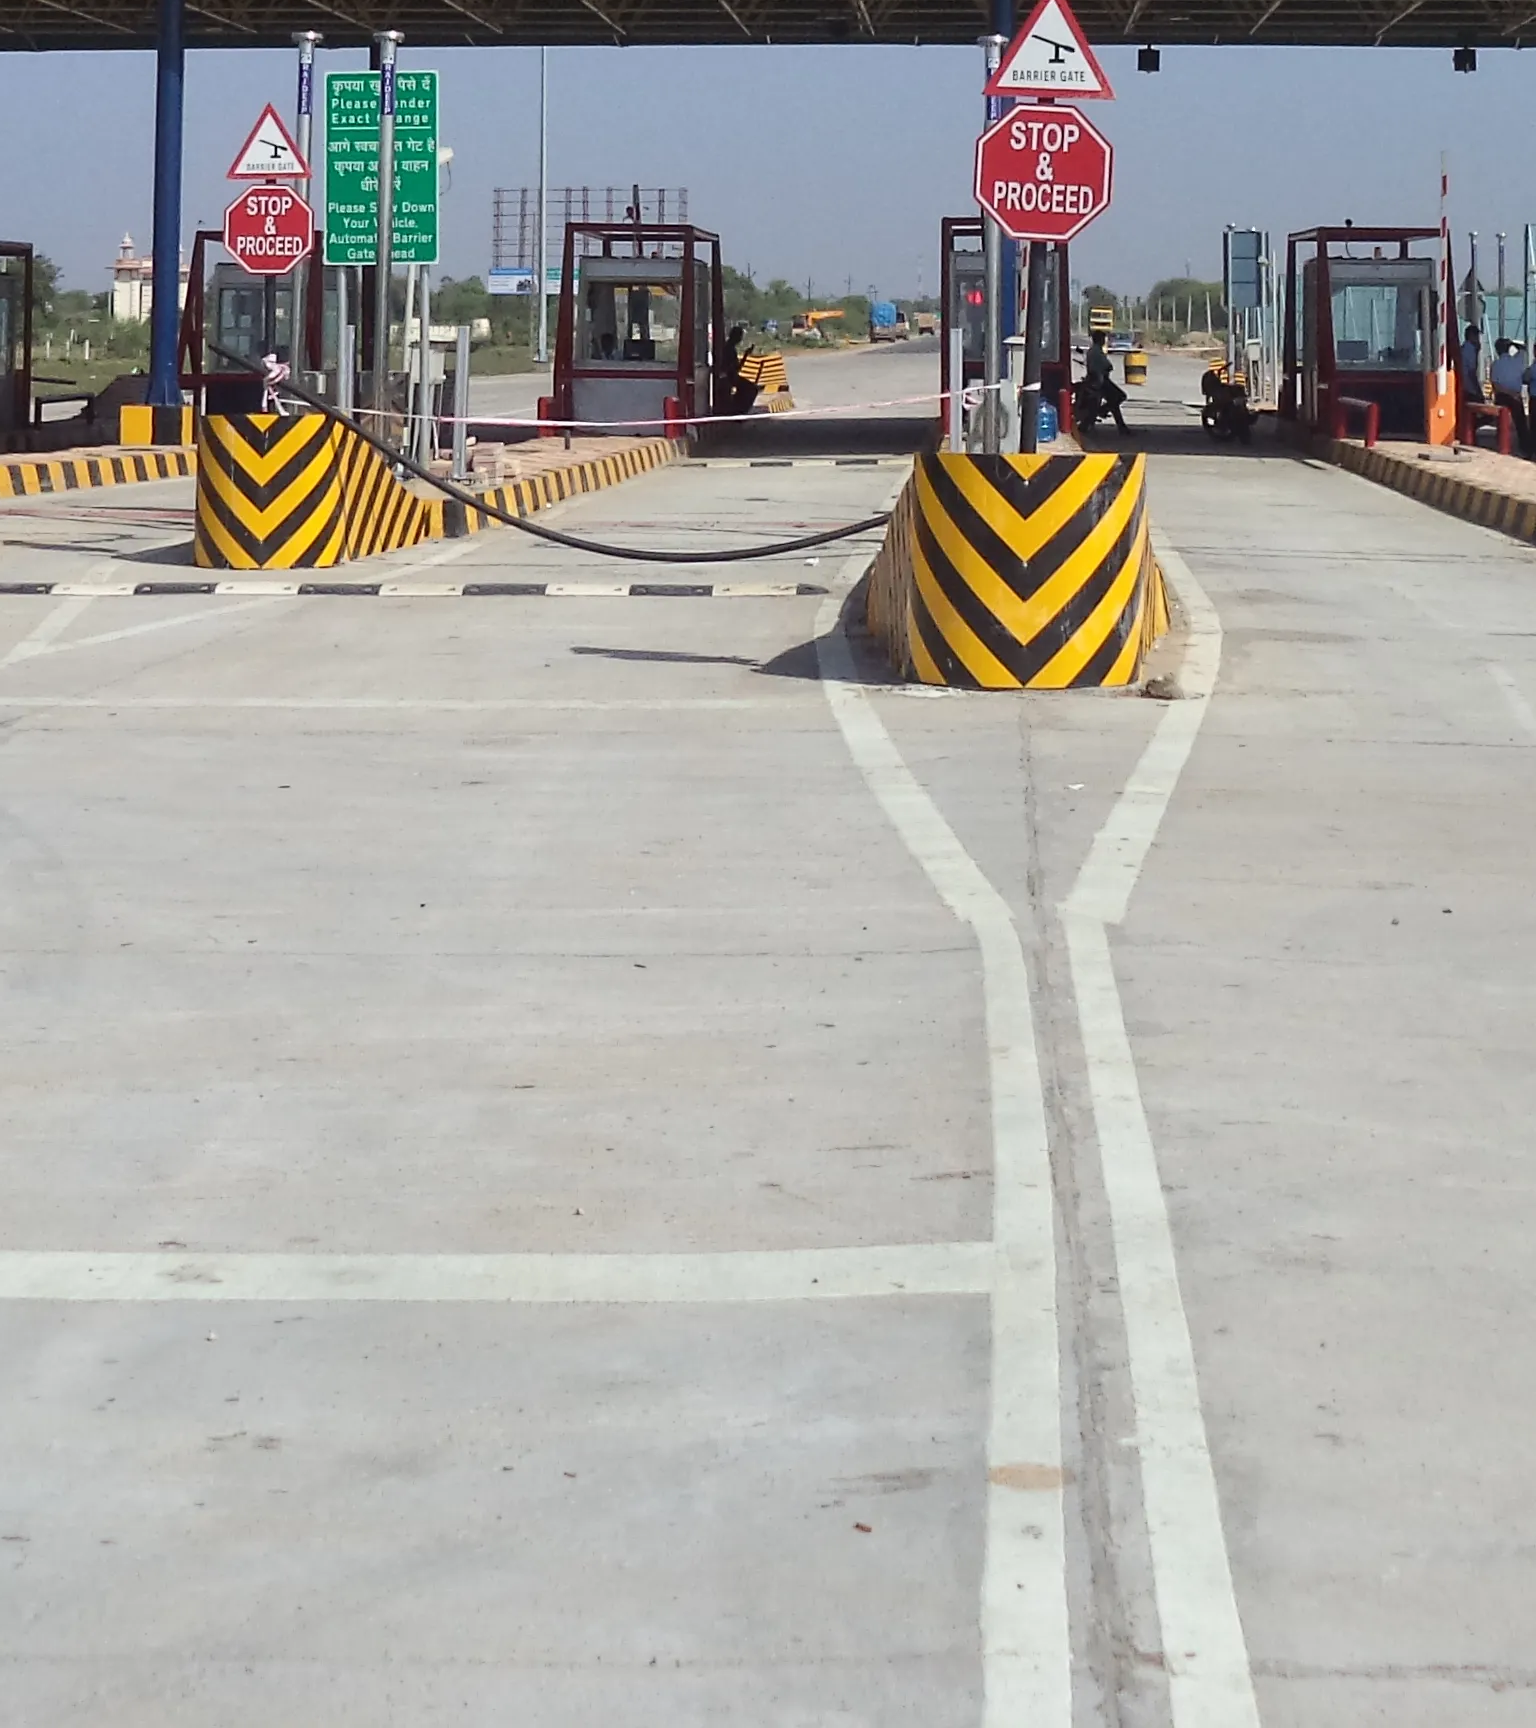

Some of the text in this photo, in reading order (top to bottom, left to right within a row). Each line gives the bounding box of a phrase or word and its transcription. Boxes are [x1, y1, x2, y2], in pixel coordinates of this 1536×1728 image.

[1012, 69, 1086, 83] BARRIER GATE
[331, 80, 364, 96] कृपया
[331, 98, 377, 109] Please
[331, 113, 428, 125] Exact ange
[328, 137, 350, 152] आगे
[405, 137, 424, 152] गेट
[1009, 121, 1080, 153] STOP
[332, 160, 364, 177] कृपया
[401, 160, 429, 173] वाहन
[1035, 152, 1054, 182] &
[993, 180, 1094, 215] PROCEED
[246, 196, 293, 216] STOP
[328, 202, 365, 213] Please
[402, 201, 435, 213] Down
[264, 216, 276, 235] &
[343, 217, 370, 229] Your
[329, 232, 433, 244] Automat Barrier
[236, 236, 303, 257] PROCEED
[347, 248, 375, 259] Gate
